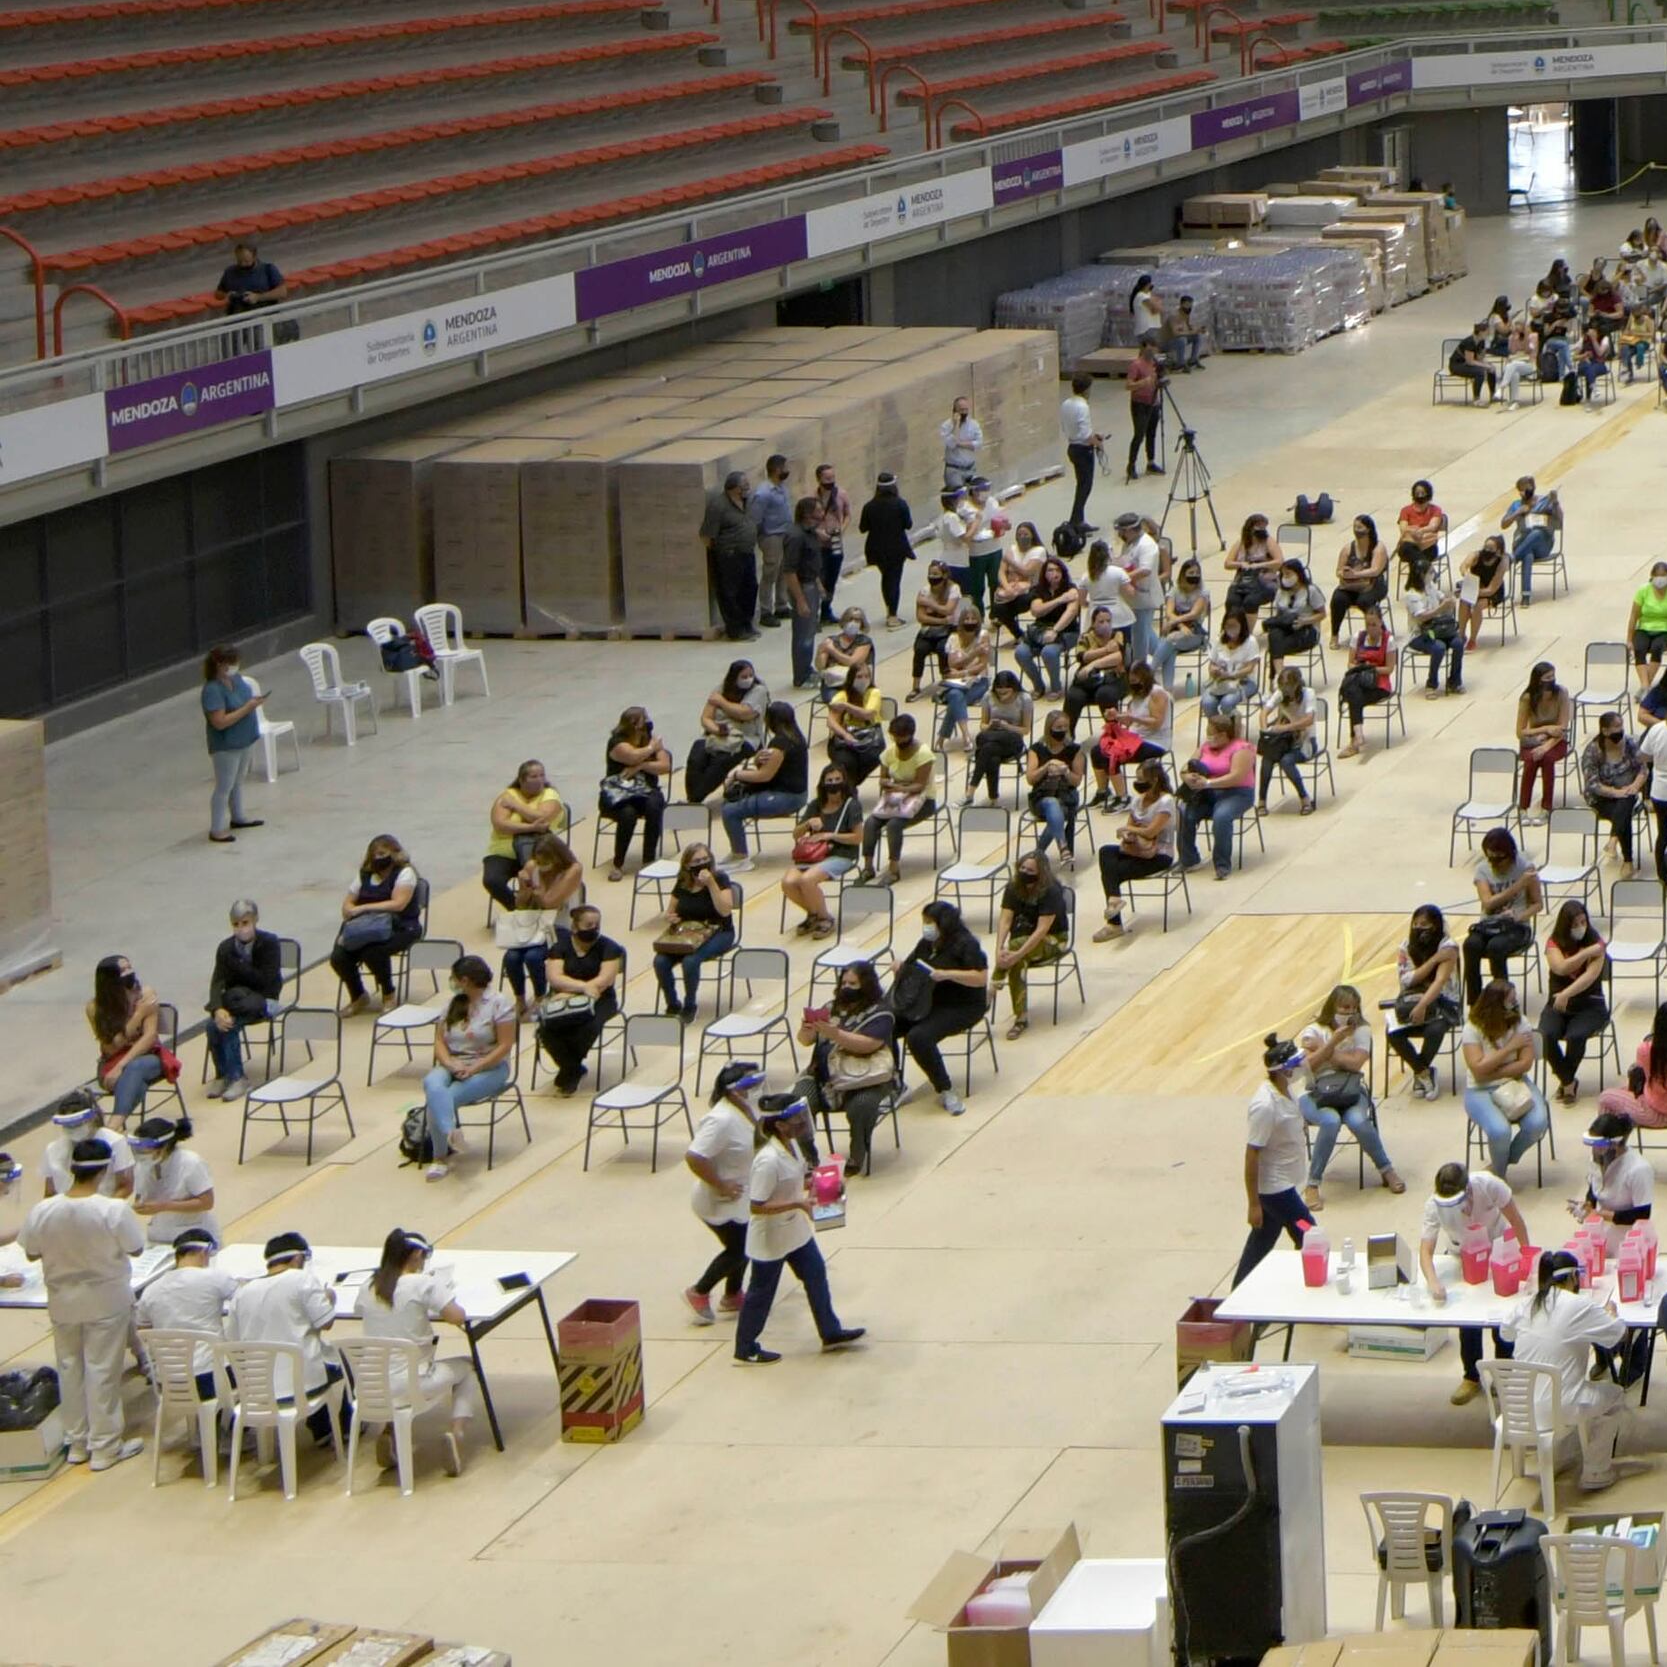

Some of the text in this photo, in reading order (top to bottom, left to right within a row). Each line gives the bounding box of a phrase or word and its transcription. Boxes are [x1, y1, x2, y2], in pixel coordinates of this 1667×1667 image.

[1552, 54, 1594, 63] MENDOZA
[911, 188, 943, 205] MENDOZA
[649, 246, 751, 283] MENDOZA ARGENTINA
[445, 306, 497, 331] MENDOZA
[446, 323, 498, 348] ARGENTINA
[111, 371, 270, 426] MENDOZA ARGENTINA
